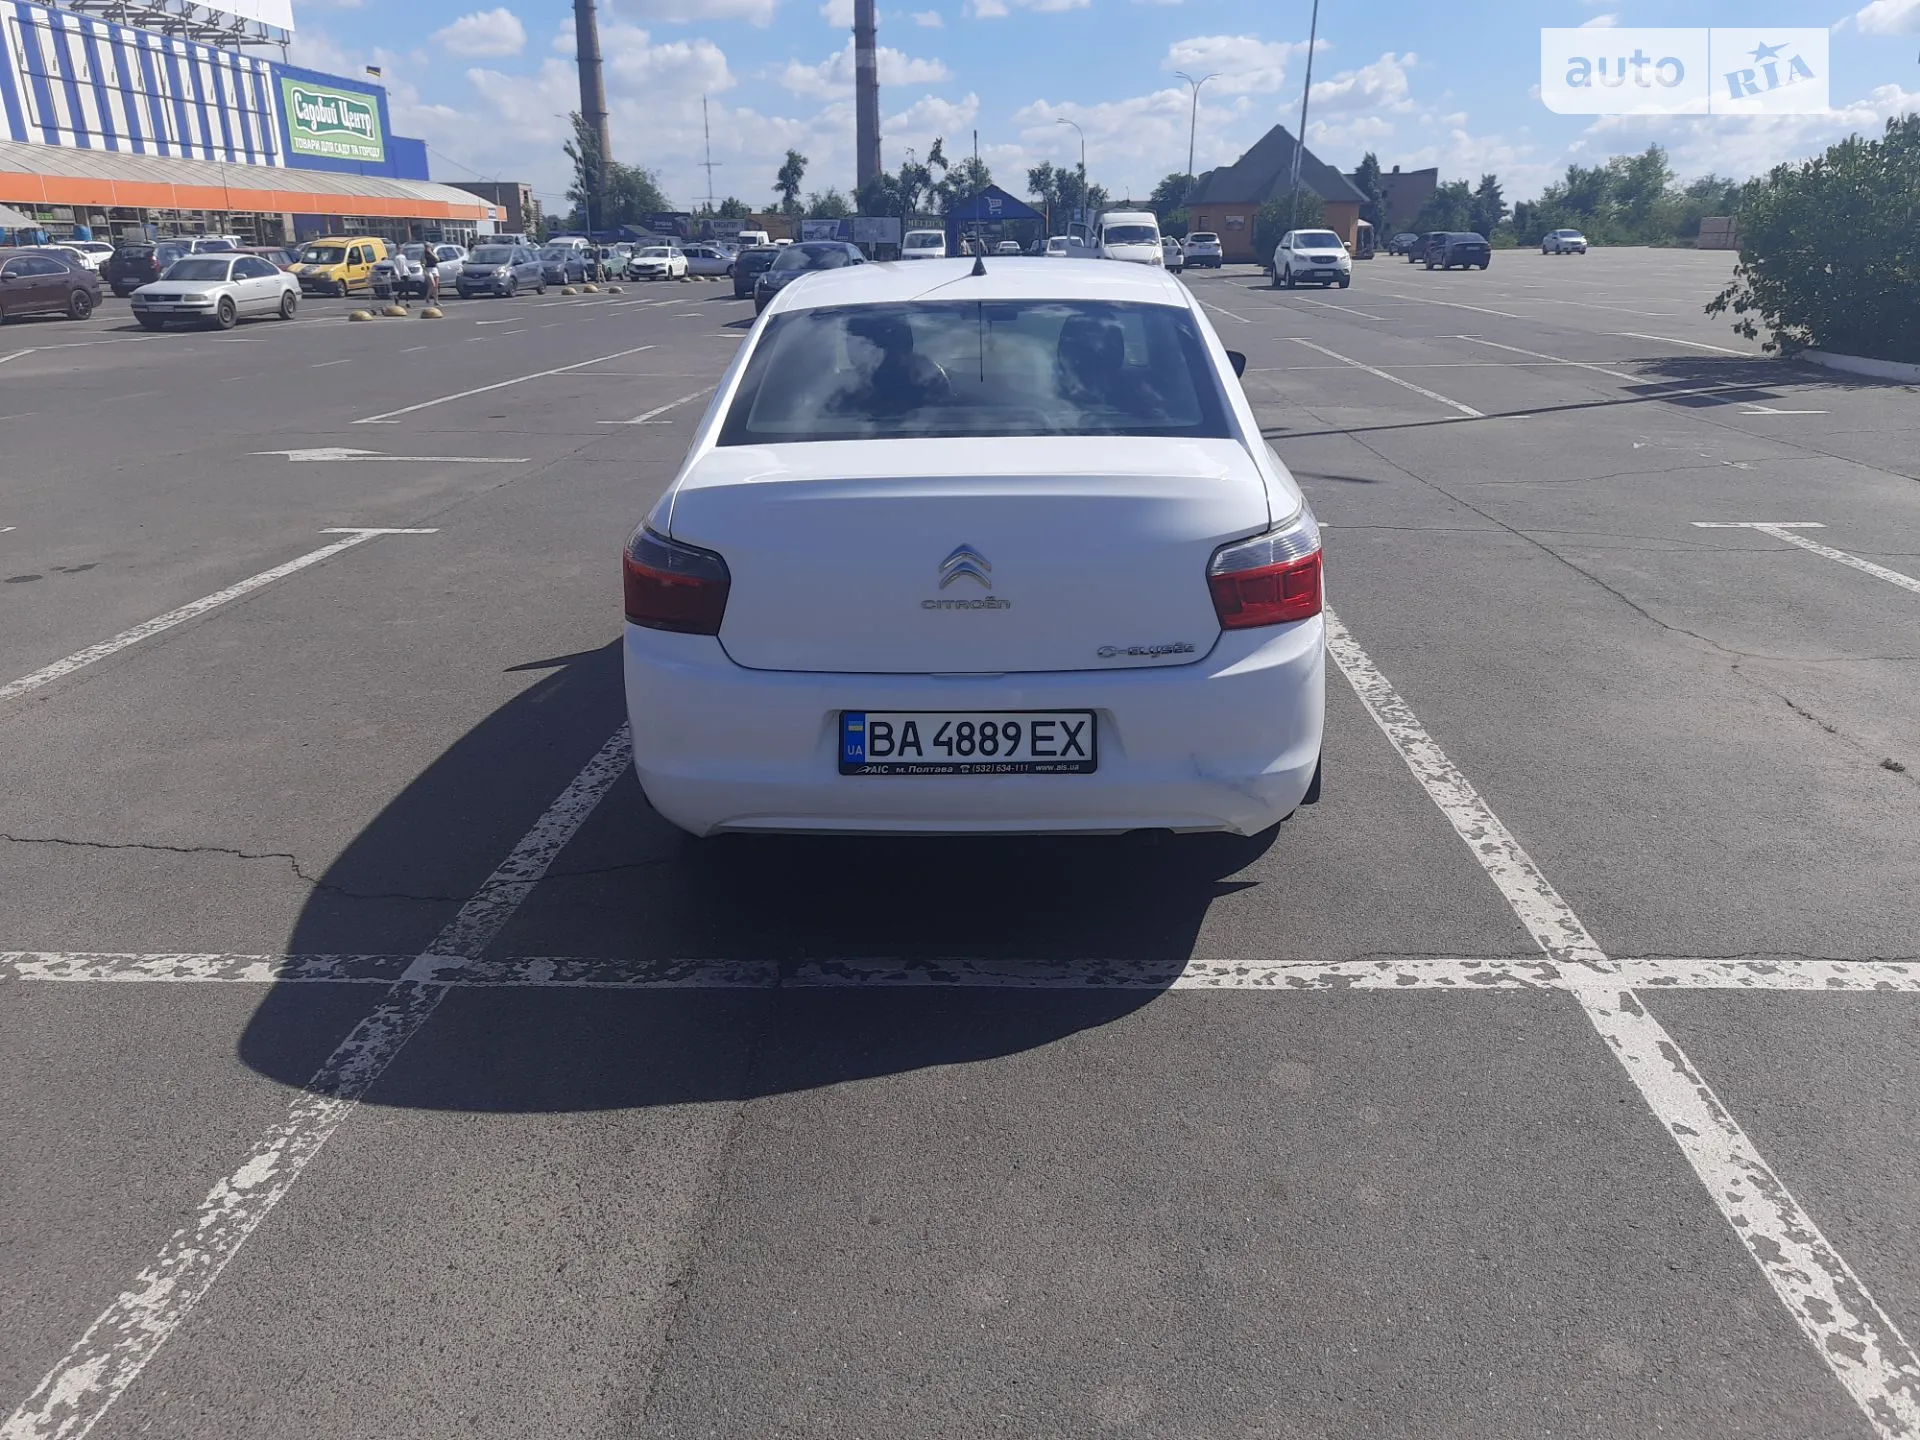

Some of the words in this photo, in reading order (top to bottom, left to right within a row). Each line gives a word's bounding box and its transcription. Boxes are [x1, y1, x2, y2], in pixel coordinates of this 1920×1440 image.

[294, 93, 338, 130] Садовий
[338, 101, 372, 137] Центр
[294, 137, 320, 150] ТОВАРИ
[321, 141, 334, 153] ДЛЯ
[334, 143, 350, 155] САДУ
[869, 720, 923, 757] BA
[933, 720, 1022, 757] 4889
[1031, 720, 1086, 757] EX
[847, 744, 863, 756] UA
[908, 764, 954, 774] Полтава
